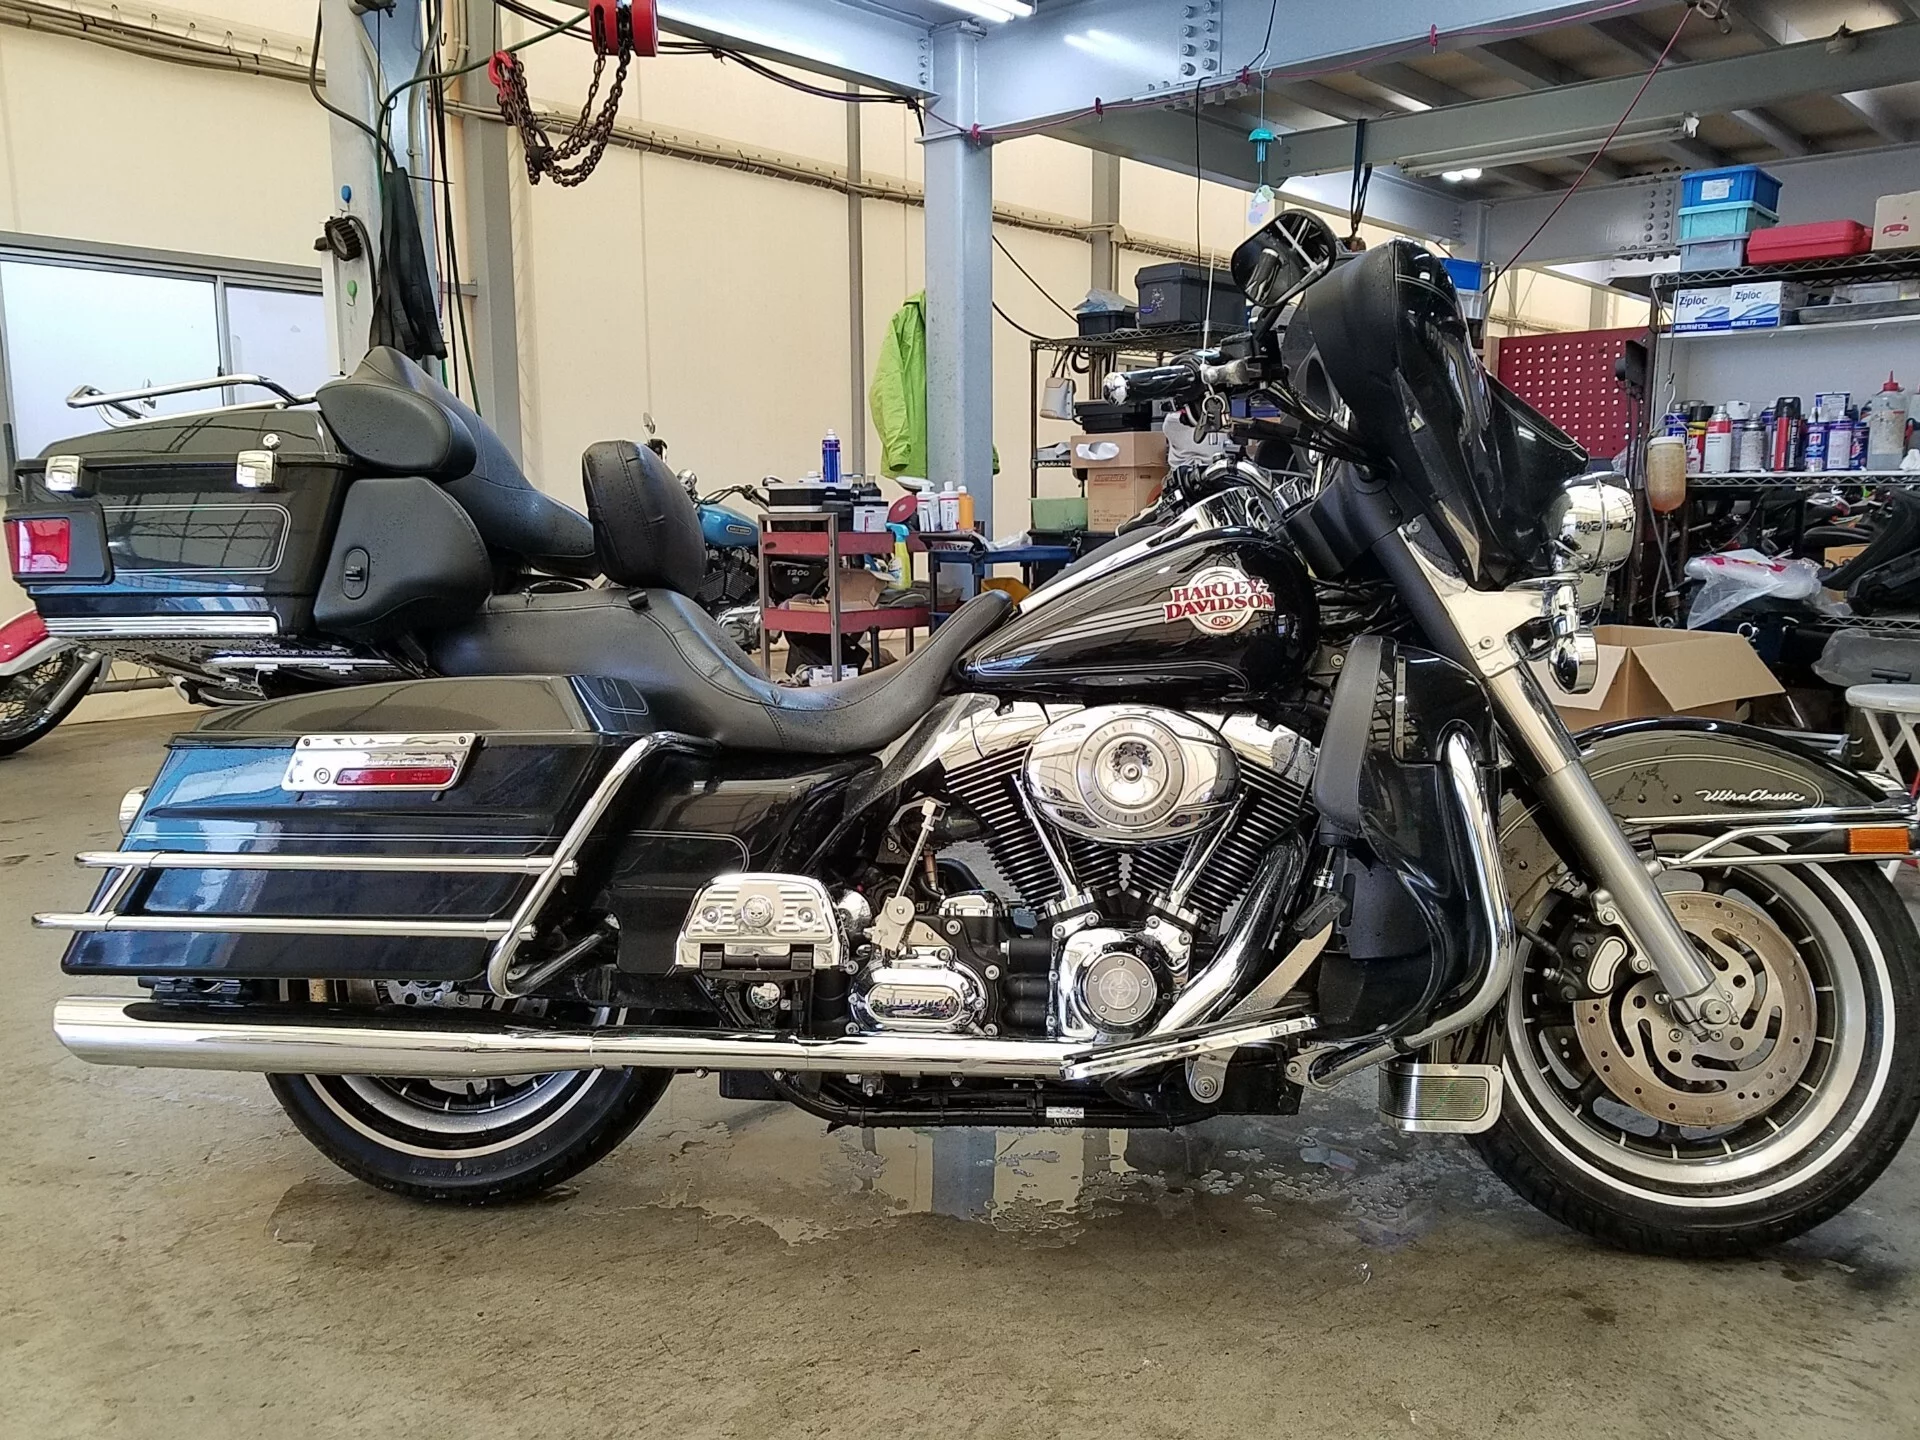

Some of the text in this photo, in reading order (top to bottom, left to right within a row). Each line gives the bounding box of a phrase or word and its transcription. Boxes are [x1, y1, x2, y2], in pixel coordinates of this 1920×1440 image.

[1680, 296, 1707, 308] Ziploc
[1735, 291, 1761, 302] Ziploc
[787, 569, 809, 577] 1200
[1164, 593, 1275, 620] DAVIDSON
